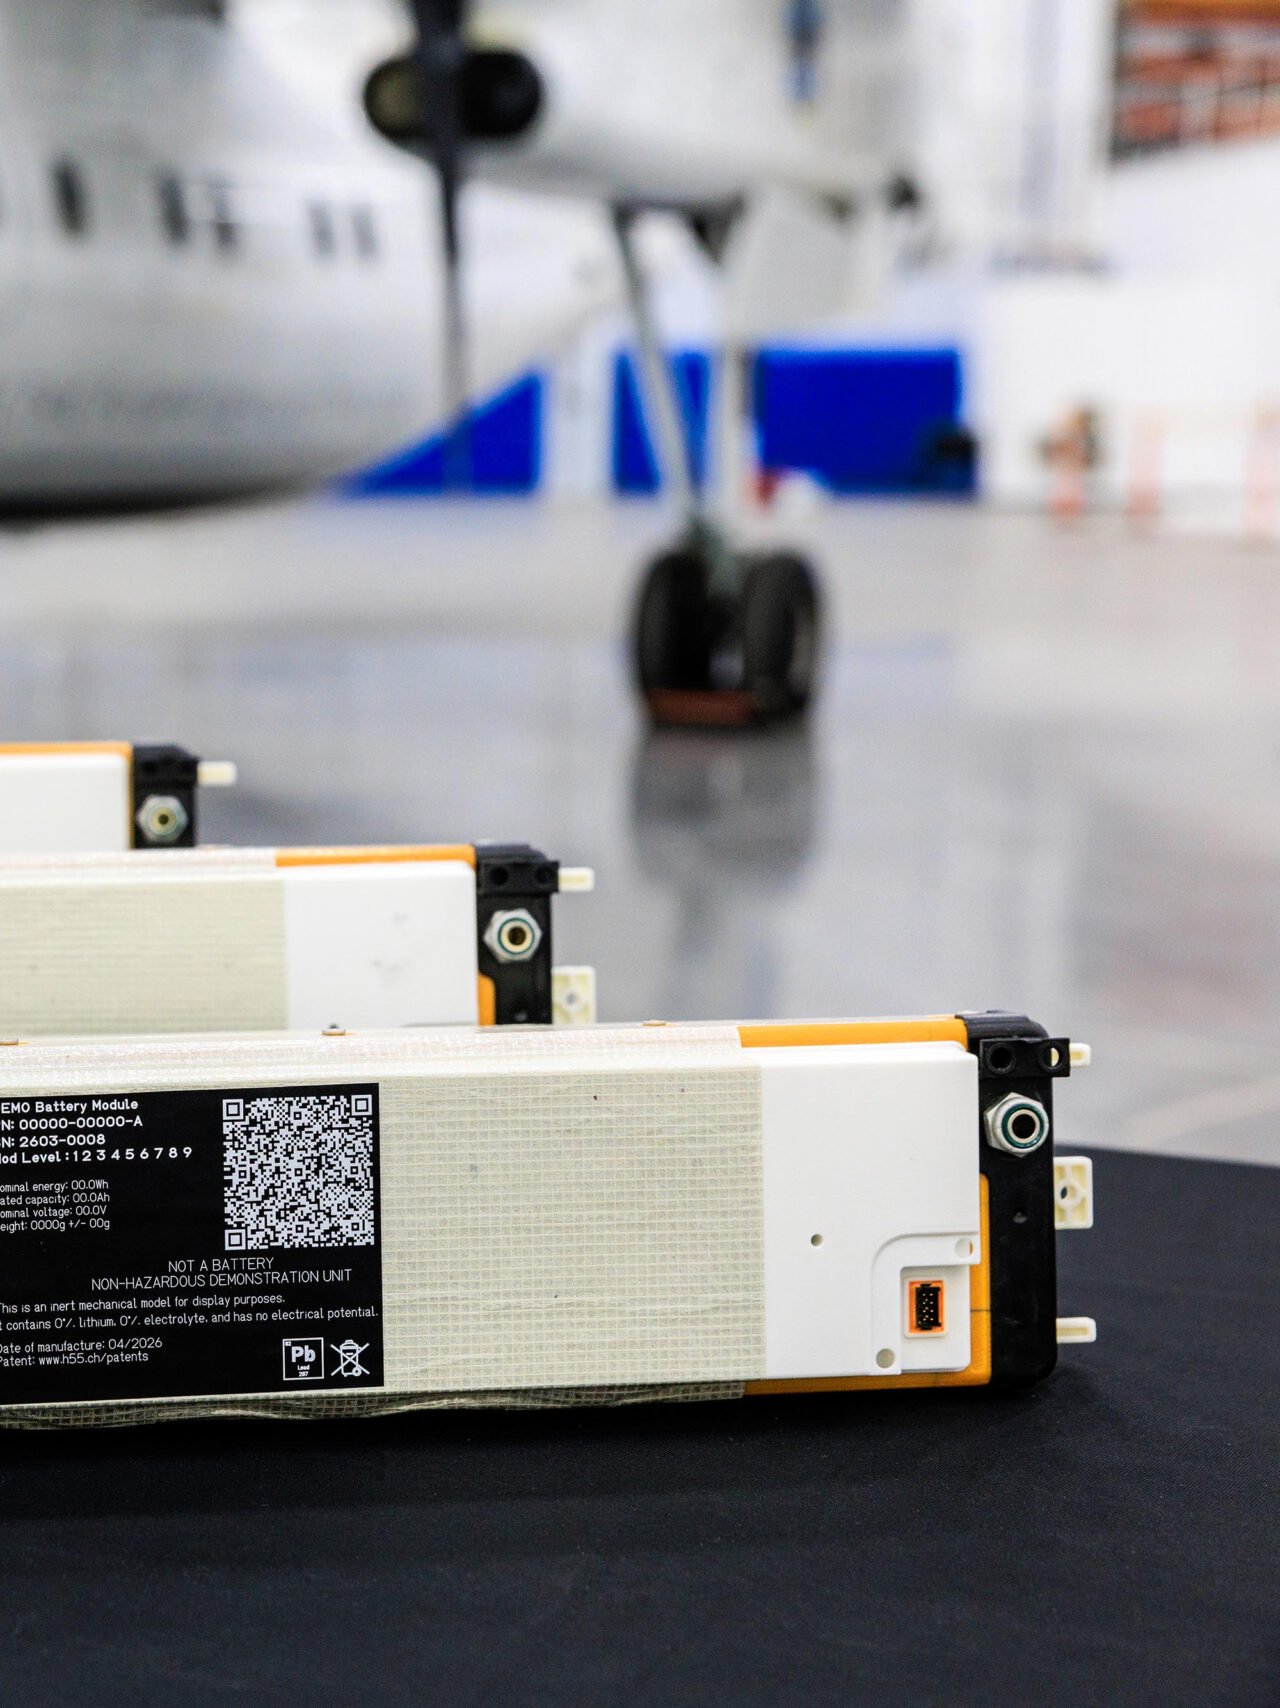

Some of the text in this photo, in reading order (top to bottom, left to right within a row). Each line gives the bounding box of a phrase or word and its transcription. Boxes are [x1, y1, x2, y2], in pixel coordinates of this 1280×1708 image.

[36, 1101, 86, 1114] Battery
[92, 1099, 138, 1111] Module
[20, 1116, 143, 1130] 00000-00000-A
[20, 1134, 105, 1148] 2603-0008
[82, 1150, 91, 1161] 2
[97, 1150, 105, 1160] 3
[111, 1149, 120, 1160] 4
[126, 1149, 134, 1159] 5
[140, 1148, 149, 1159] 6
[154, 1148, 163, 1159] 7
[169, 1147, 177, 1158] 8
[183, 1147, 192, 1158] 9
[33, 1182, 68, 1192] energy:
[72, 1180, 108, 1190] 00.0Wh
[26, 1194, 69, 1206] capacity:
[73, 1193, 110, 1203] 00.0Ah
[33, 1207, 72, 1218] voltage:
[76, 1205, 107, 1216] 00.0V
[31, 1220, 65, 1231] 0000g
[69, 1219, 86, 1229] +/-
[90, 1218, 110, 1230] 00g
[169, 1257, 274, 1272] NOT A BATTERY
[91, 1269, 352, 1291] NON-HAZARDOUS DEMONSTRATION UNIT
[22, 1303, 30, 1313] is
[34, 1303, 46, 1312] an
[50, 1300, 75, 1312] inert
[79, 1298, 137, 1311] mechanical
[141, 1297, 171, 1308] model
[175, 1296, 188, 1307] for
[193, 1295, 230, 1308] display
[234, 1294, 285, 1307] purposes.
[6, 1318, 51, 1330] contains
[212, 1312, 230, 1323] and
[234, 1311, 252, 1322] has
[256, 1312, 268, 1321] no
[272, 1308, 324, 1320] electrical
[328, 1306, 378, 1321] potential.
[25, 1342, 34, 1352] of
[38, 1340, 104, 1352] manufacture:
[109, 1337, 162, 1349] 04/2026
[39, 1351, 148, 1365] www.h55.ch/patents
[291, 1345, 316, 1363] Pb
